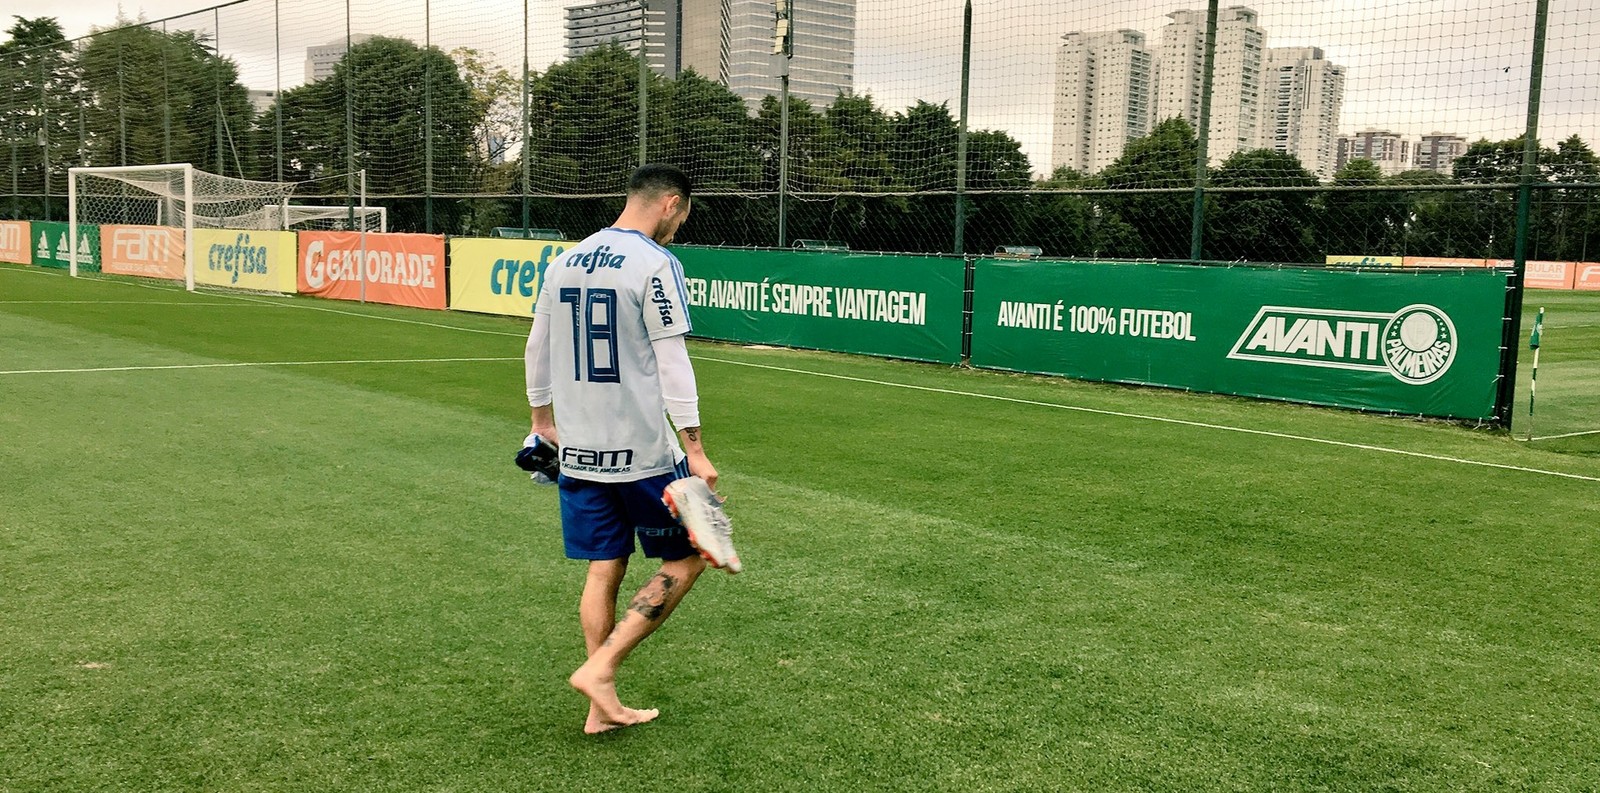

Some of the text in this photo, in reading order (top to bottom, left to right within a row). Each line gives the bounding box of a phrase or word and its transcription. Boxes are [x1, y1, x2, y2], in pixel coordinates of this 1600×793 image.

[209, 233, 267, 284] crefisa
[326, 249, 435, 289] GATORADE
[490, 245, 565, 314] cref
[566, 245, 626, 274] crefisa
[651, 277, 673, 327] crefisa
[708, 279, 758, 312] AVANTI
[760, 277, 770, 312] É
[772, 284, 833, 318] SEMPRE
[835, 287, 926, 326] VANTAGEM
[997, 300, 1197, 342] AVANTI É 100% FUTEBOL
[559, 287, 621, 384] 18
[1245, 316, 1451, 378] AVANTI PALMEIRAS
